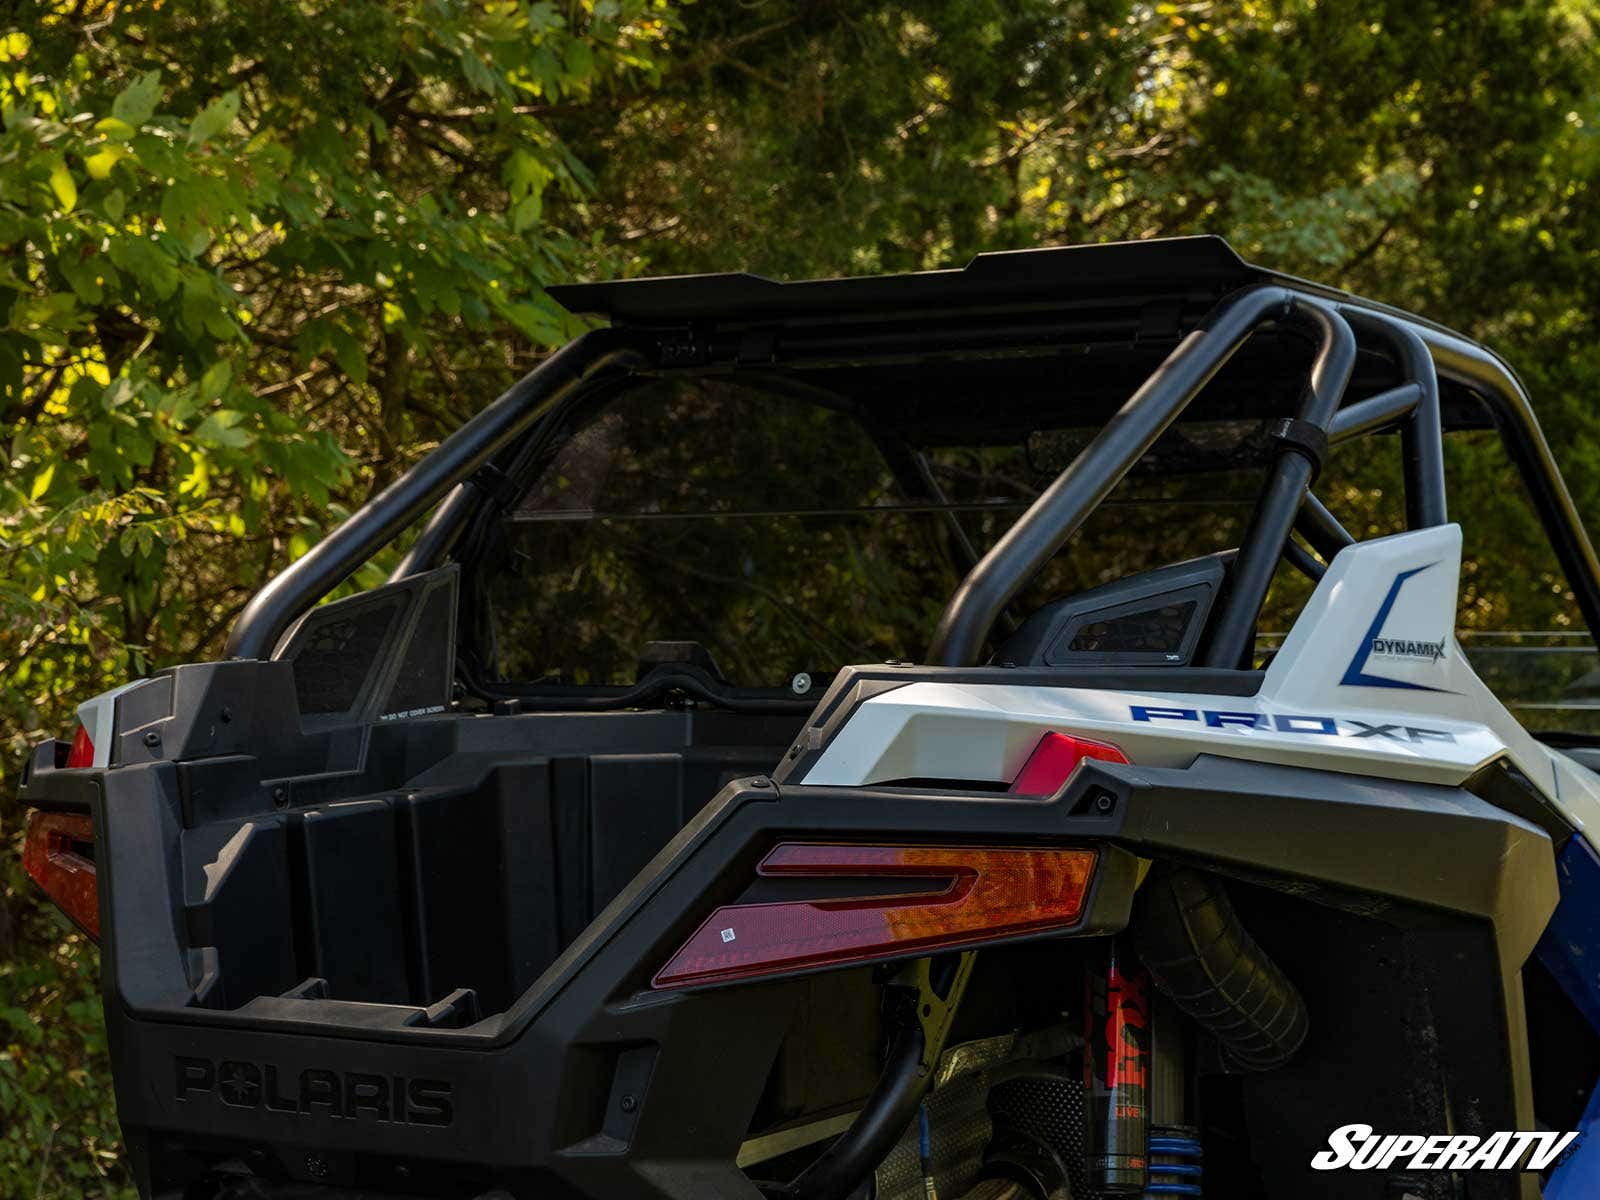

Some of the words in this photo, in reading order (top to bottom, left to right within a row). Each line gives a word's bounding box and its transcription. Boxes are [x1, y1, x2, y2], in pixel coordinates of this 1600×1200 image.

[1373, 637, 1446, 664] DYNAMIX
[1129, 705, 1339, 735] PRO
[175, 1055, 453, 1128] POLARIS
